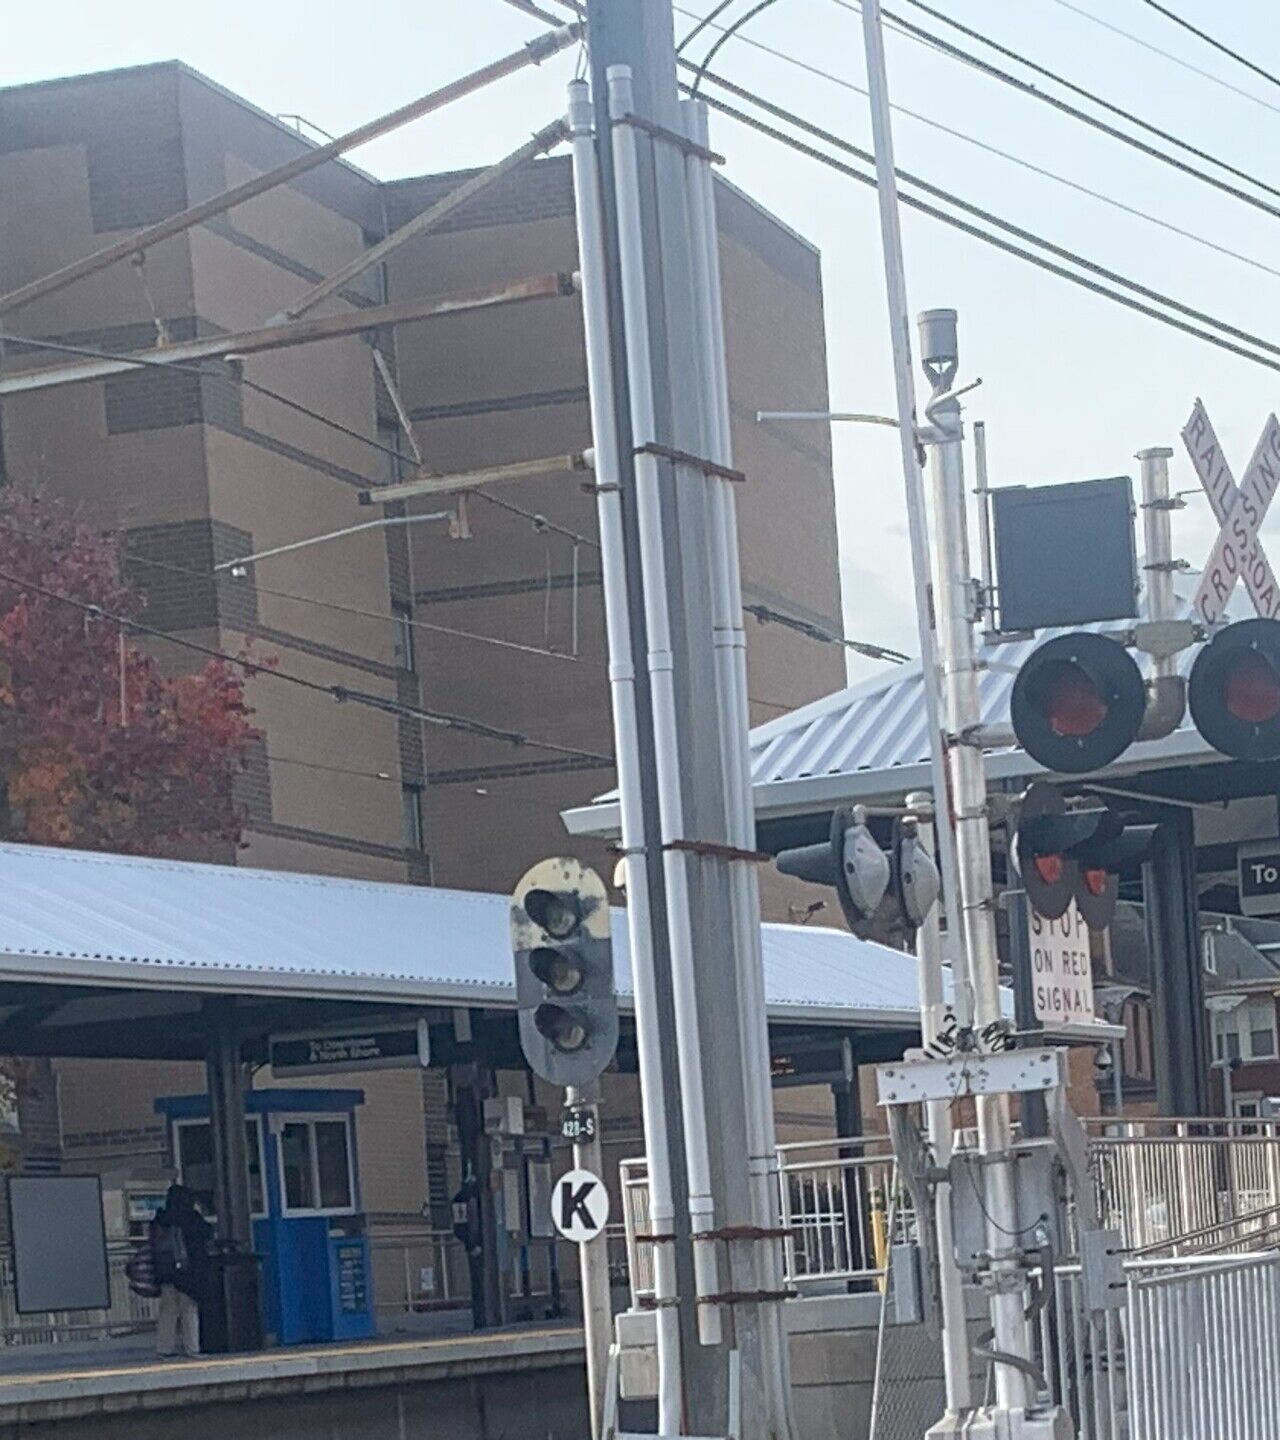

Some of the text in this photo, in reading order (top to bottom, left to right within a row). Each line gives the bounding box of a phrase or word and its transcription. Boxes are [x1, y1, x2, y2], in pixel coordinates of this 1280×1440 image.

[1251, 864, 1278, 884] To
[1034, 948, 1088, 976] ON RED
[1037, 986, 1091, 1013] SIGNAL
[561, 1181, 598, 1230] K
